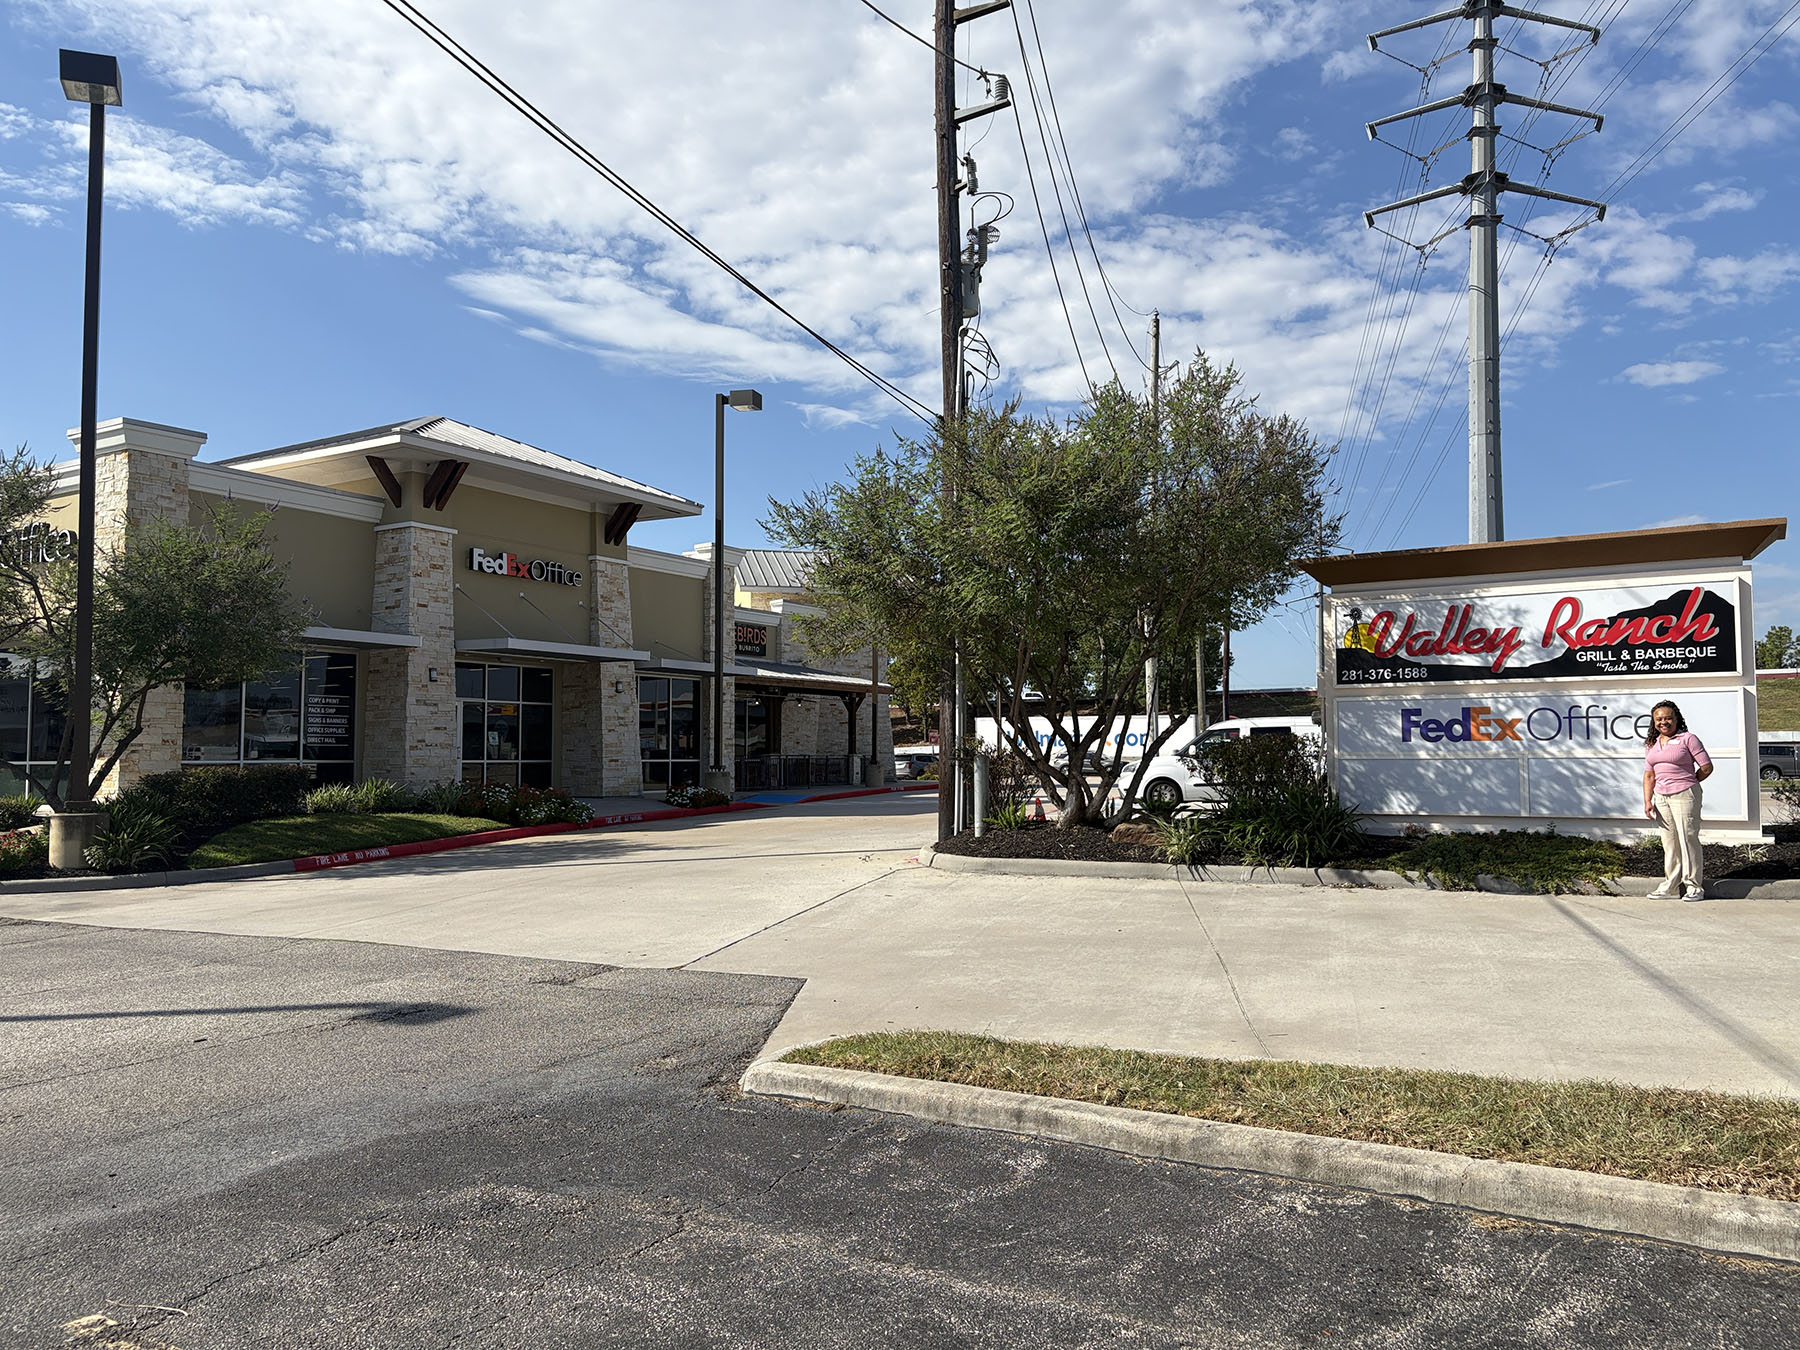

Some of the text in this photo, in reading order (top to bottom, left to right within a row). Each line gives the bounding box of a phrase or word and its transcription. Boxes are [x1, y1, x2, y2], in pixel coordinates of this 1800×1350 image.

[17, 522, 71, 564] ffice
[472, 547, 583, 587] FedEx Office
[1367, 587, 1720, 674] Valley Ranch
[1576, 646, 1717, 662] GRILL & BARBEQUE
[1630, 661, 1650, 671] The
[1341, 667, 1428, 681] 281-376-1588
[1401, 705, 1652, 743] FedEx Office
[315, 855, 331, 866] FIRE
[333, 852, 350, 863] LANE
[365, 847, 390, 859] PARKING
